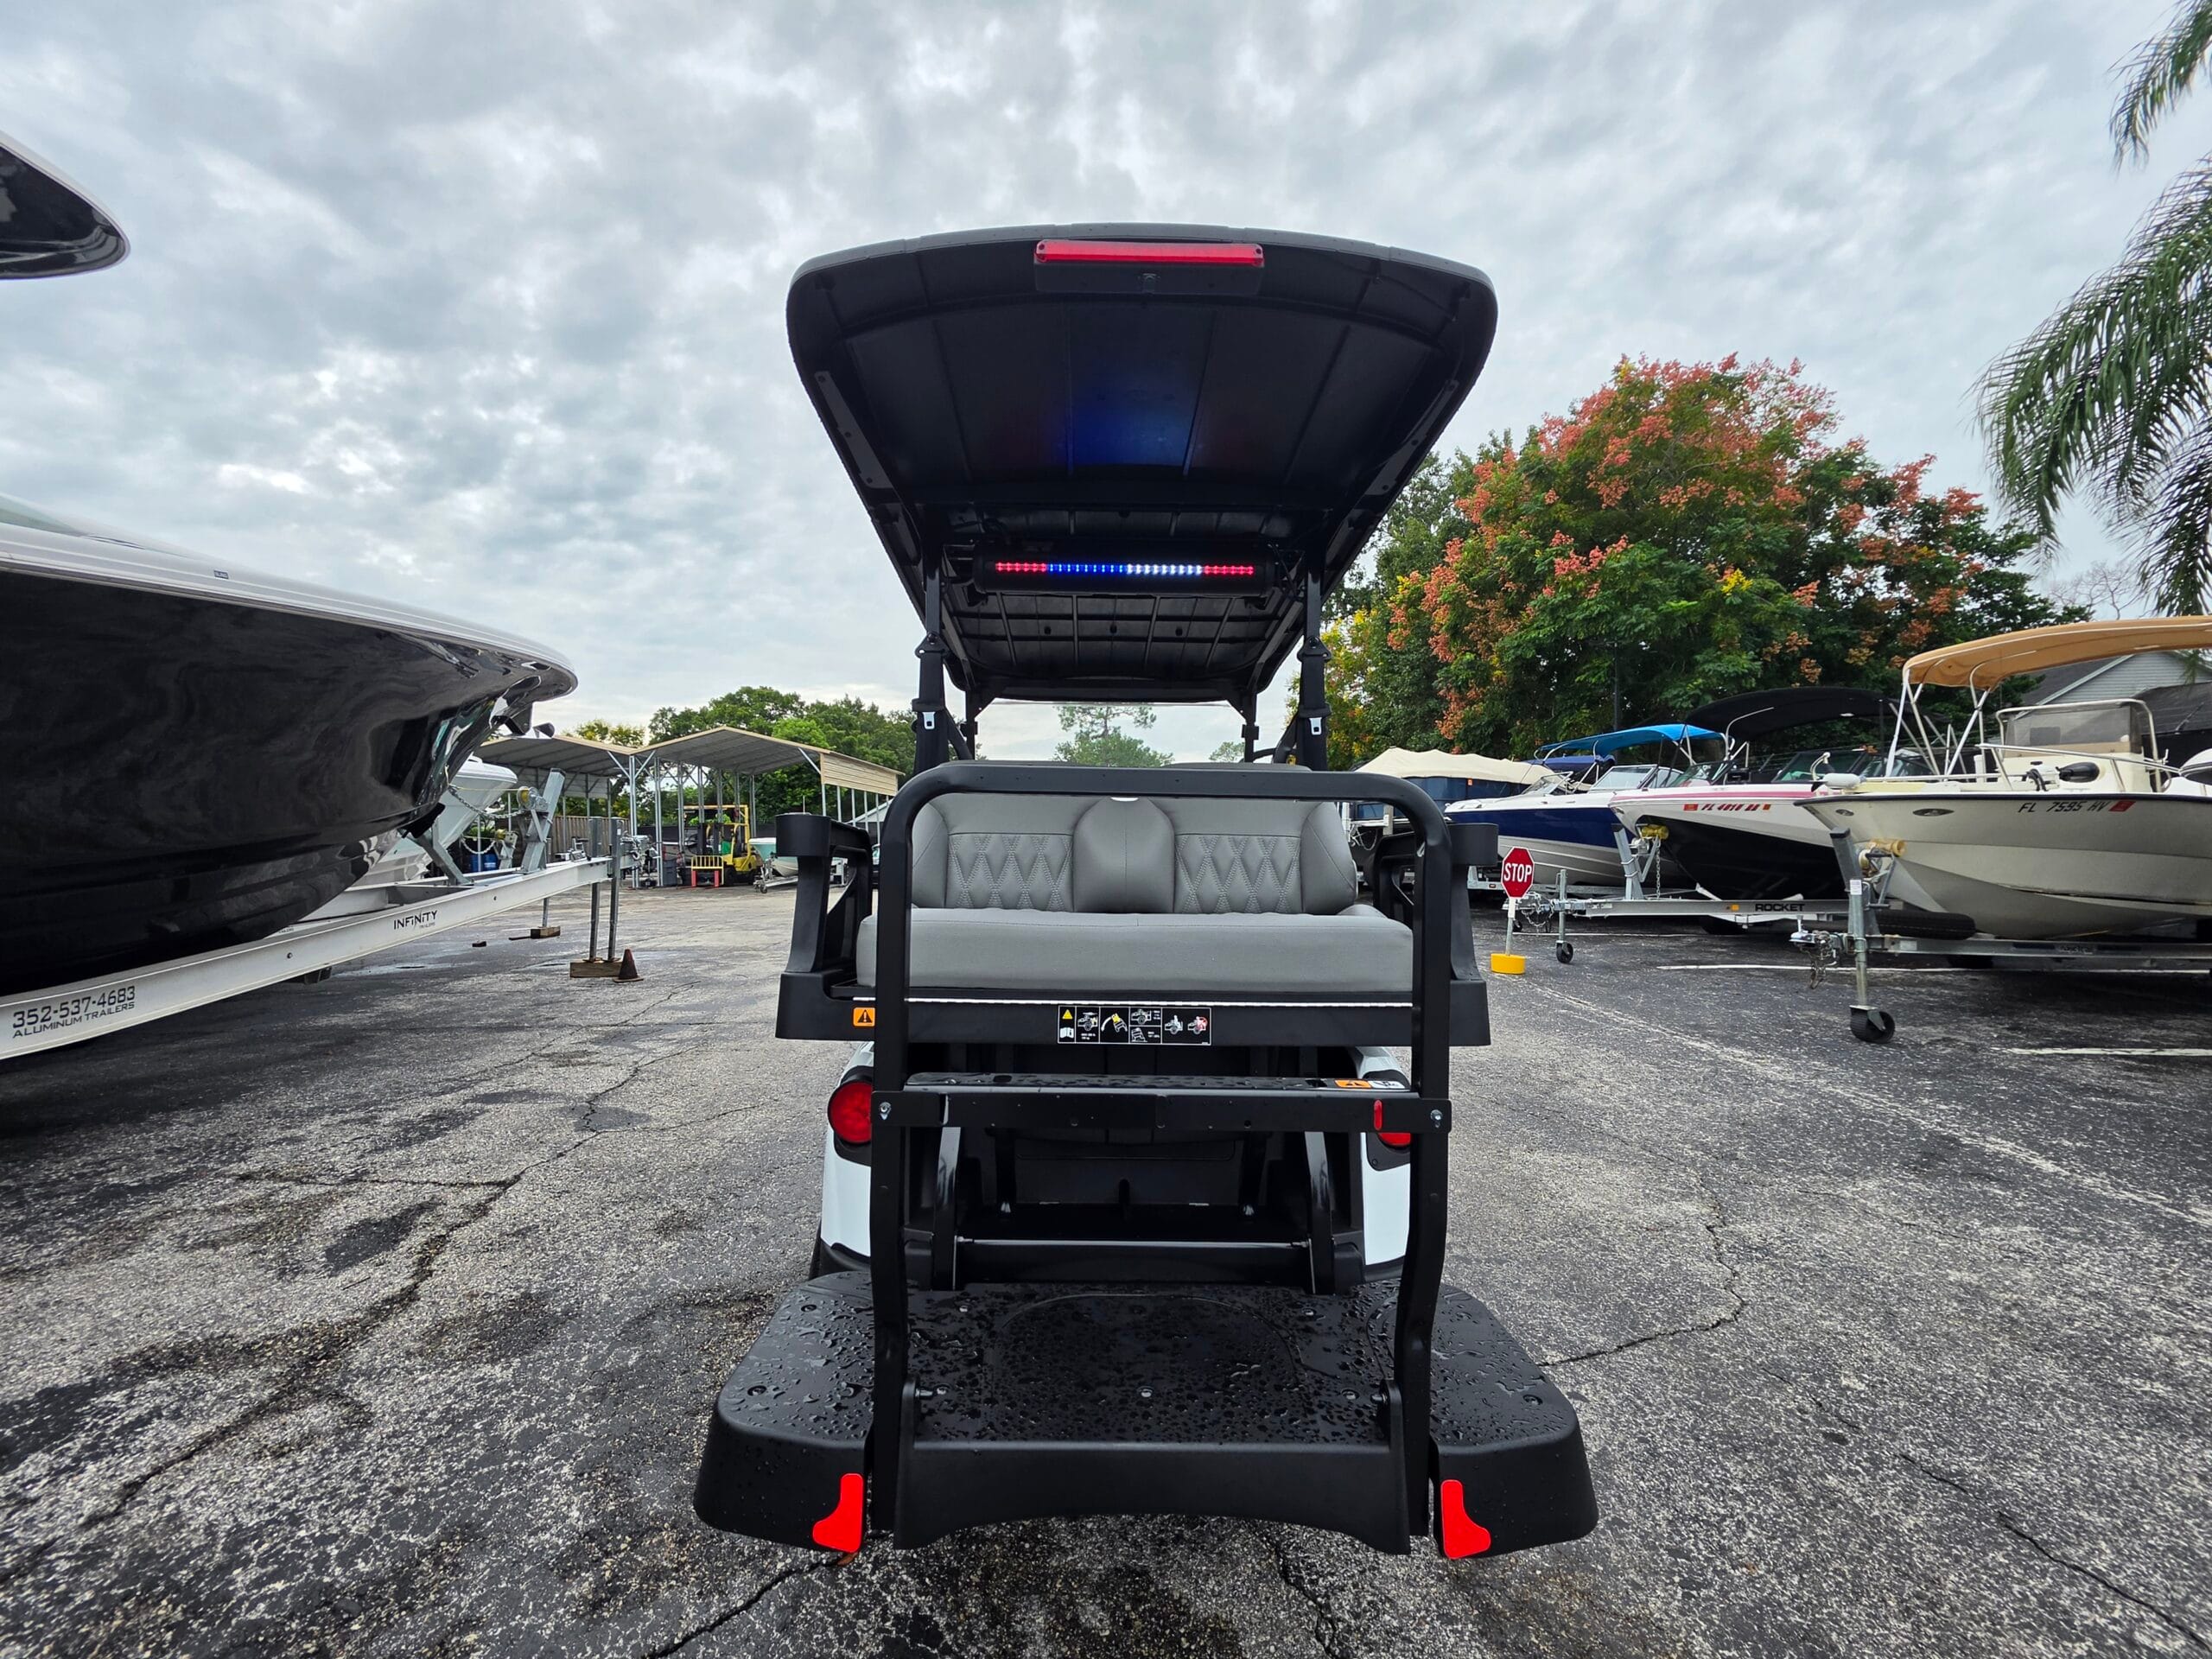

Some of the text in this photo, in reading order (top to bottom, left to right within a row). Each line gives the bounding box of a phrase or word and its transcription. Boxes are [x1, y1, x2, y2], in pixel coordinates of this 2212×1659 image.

[2018, 802, 2037, 812] FL
[1503, 862, 1532, 882] STOP
[1755, 903, 1805, 912] ROCKET
[12, 985, 136, 1028] 352-537-4683
[12, 1001, 136, 1039] ALUMINUM TRAILERS
